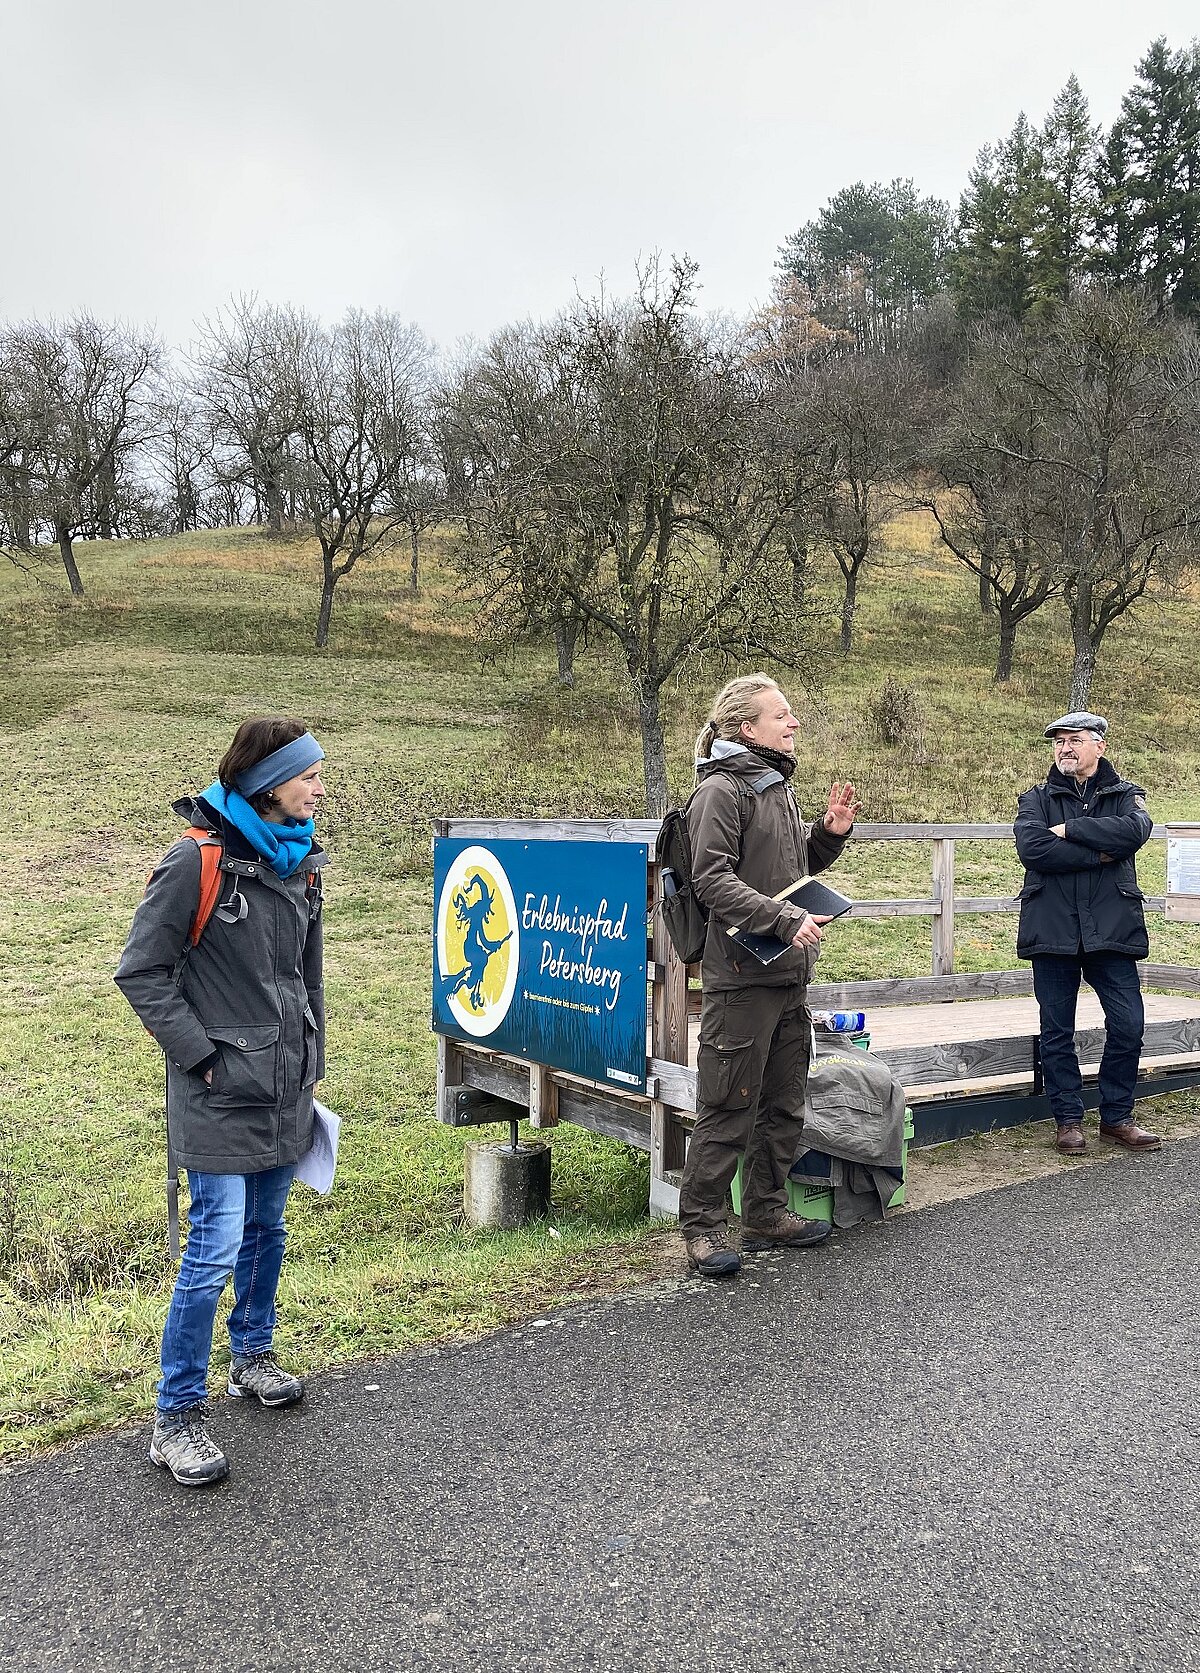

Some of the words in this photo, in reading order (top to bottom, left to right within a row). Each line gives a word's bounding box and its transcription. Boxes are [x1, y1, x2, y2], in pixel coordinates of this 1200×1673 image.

[522, 893, 628, 956] Erlebnispfad
[540, 940, 621, 1010] Petersberg
[552, 998, 562, 1006] oder
[580, 1003, 593, 1013] Gipfel
